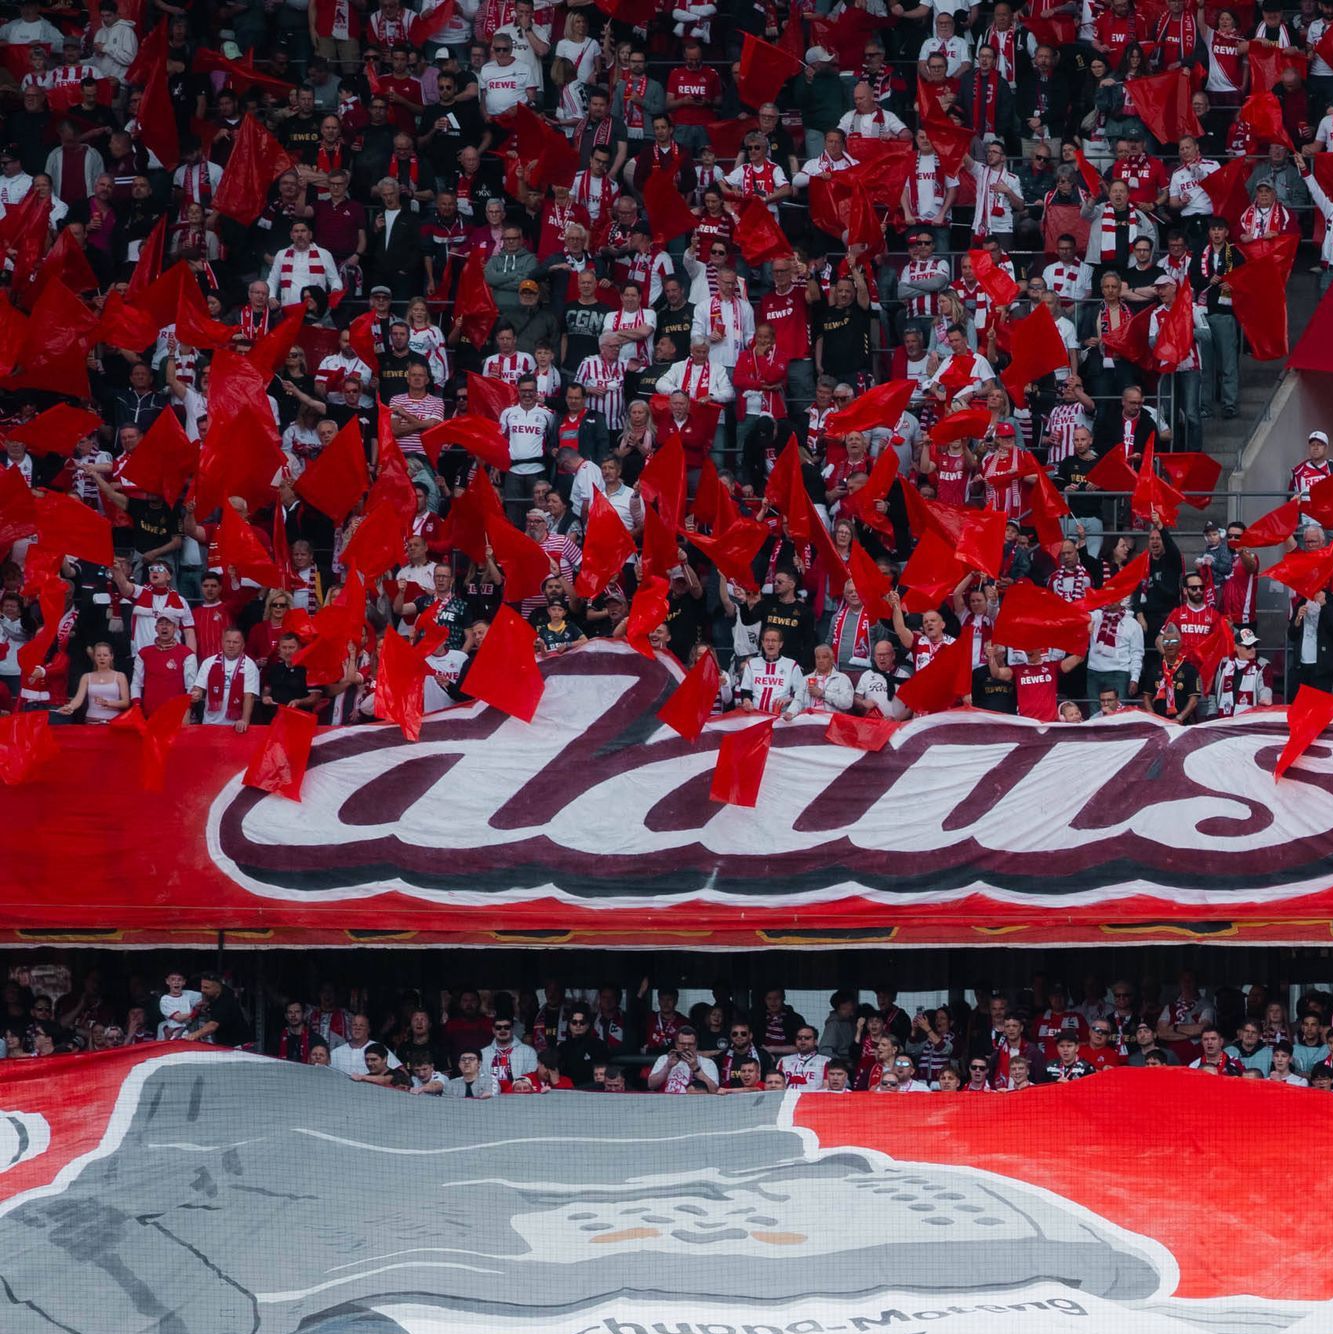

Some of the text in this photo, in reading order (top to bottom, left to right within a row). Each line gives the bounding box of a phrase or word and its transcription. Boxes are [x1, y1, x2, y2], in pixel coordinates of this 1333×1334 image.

[488, 82, 518, 92] REWE
[677, 84, 707, 95] REWE
[1179, 177, 1201, 189] REW
[698, 222, 719, 234] REW
[511, 424, 542, 435] REWE
[938, 472, 963, 483] REWE
[766, 613, 791, 625] REWE
[1180, 621, 1211, 634] REWE
[753, 674, 784, 687] REWE
[1019, 672, 1044, 684] REWE
